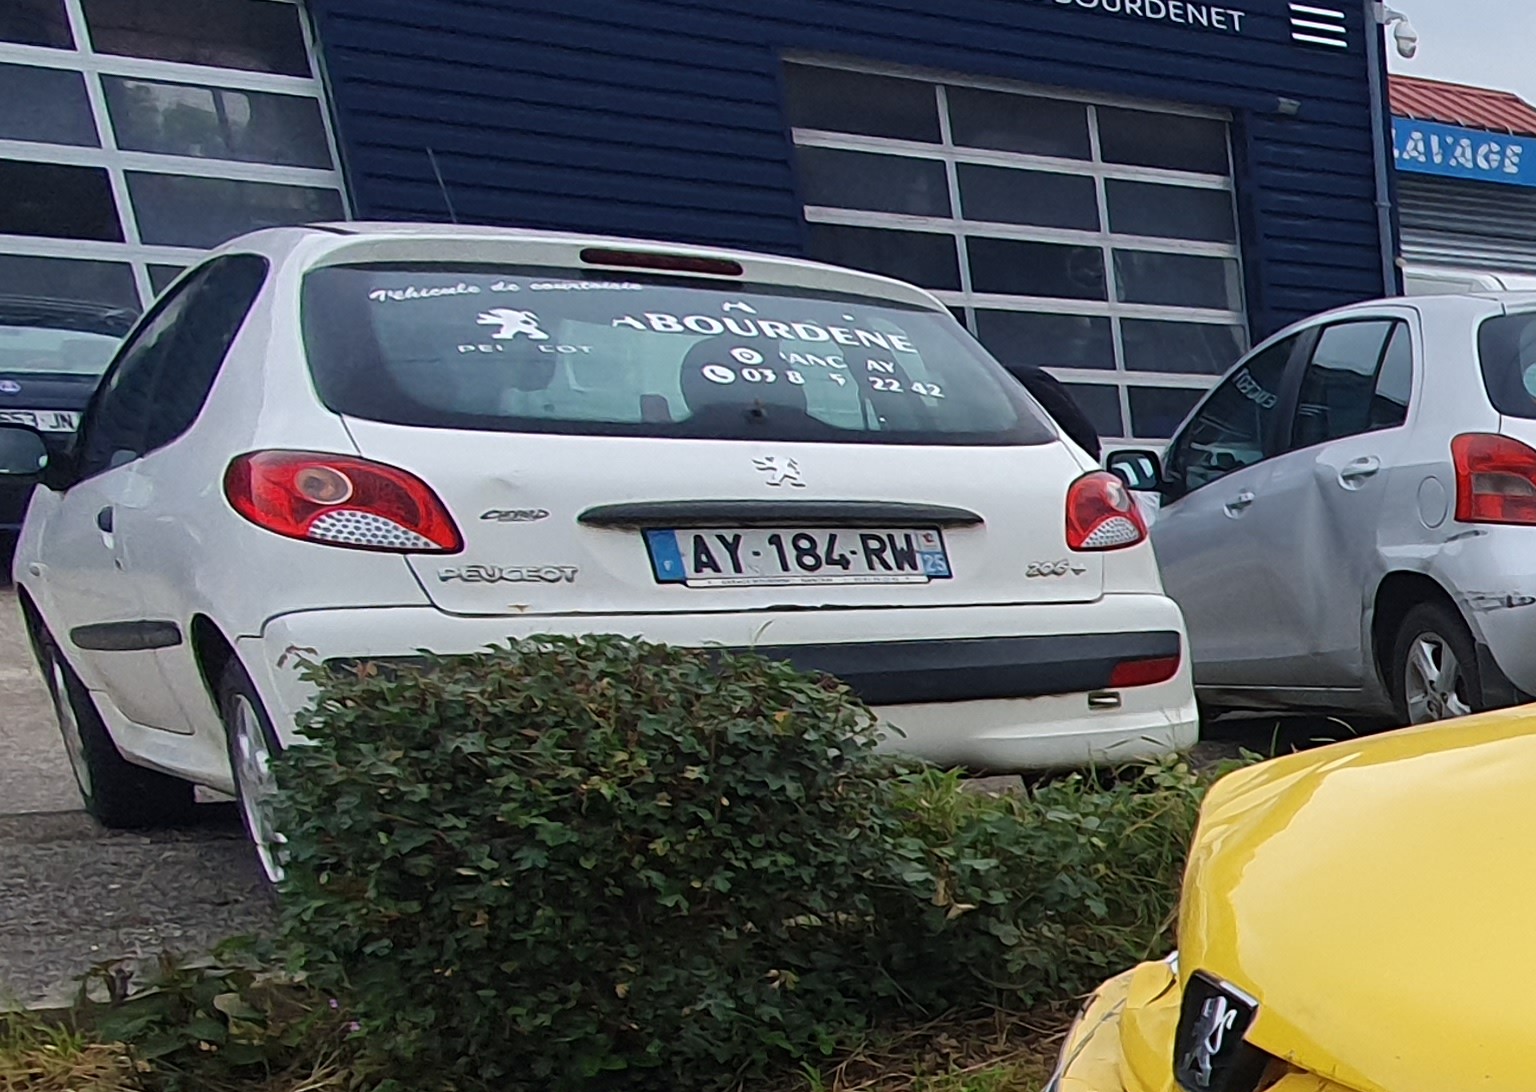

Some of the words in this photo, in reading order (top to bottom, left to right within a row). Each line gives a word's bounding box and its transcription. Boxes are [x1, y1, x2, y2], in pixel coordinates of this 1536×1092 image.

[740, 367, 777, 384] 03
[868, 376, 904, 393] 22
[923, 554, 945, 572] 25
[438, 565, 579, 583] PEUGEOT
